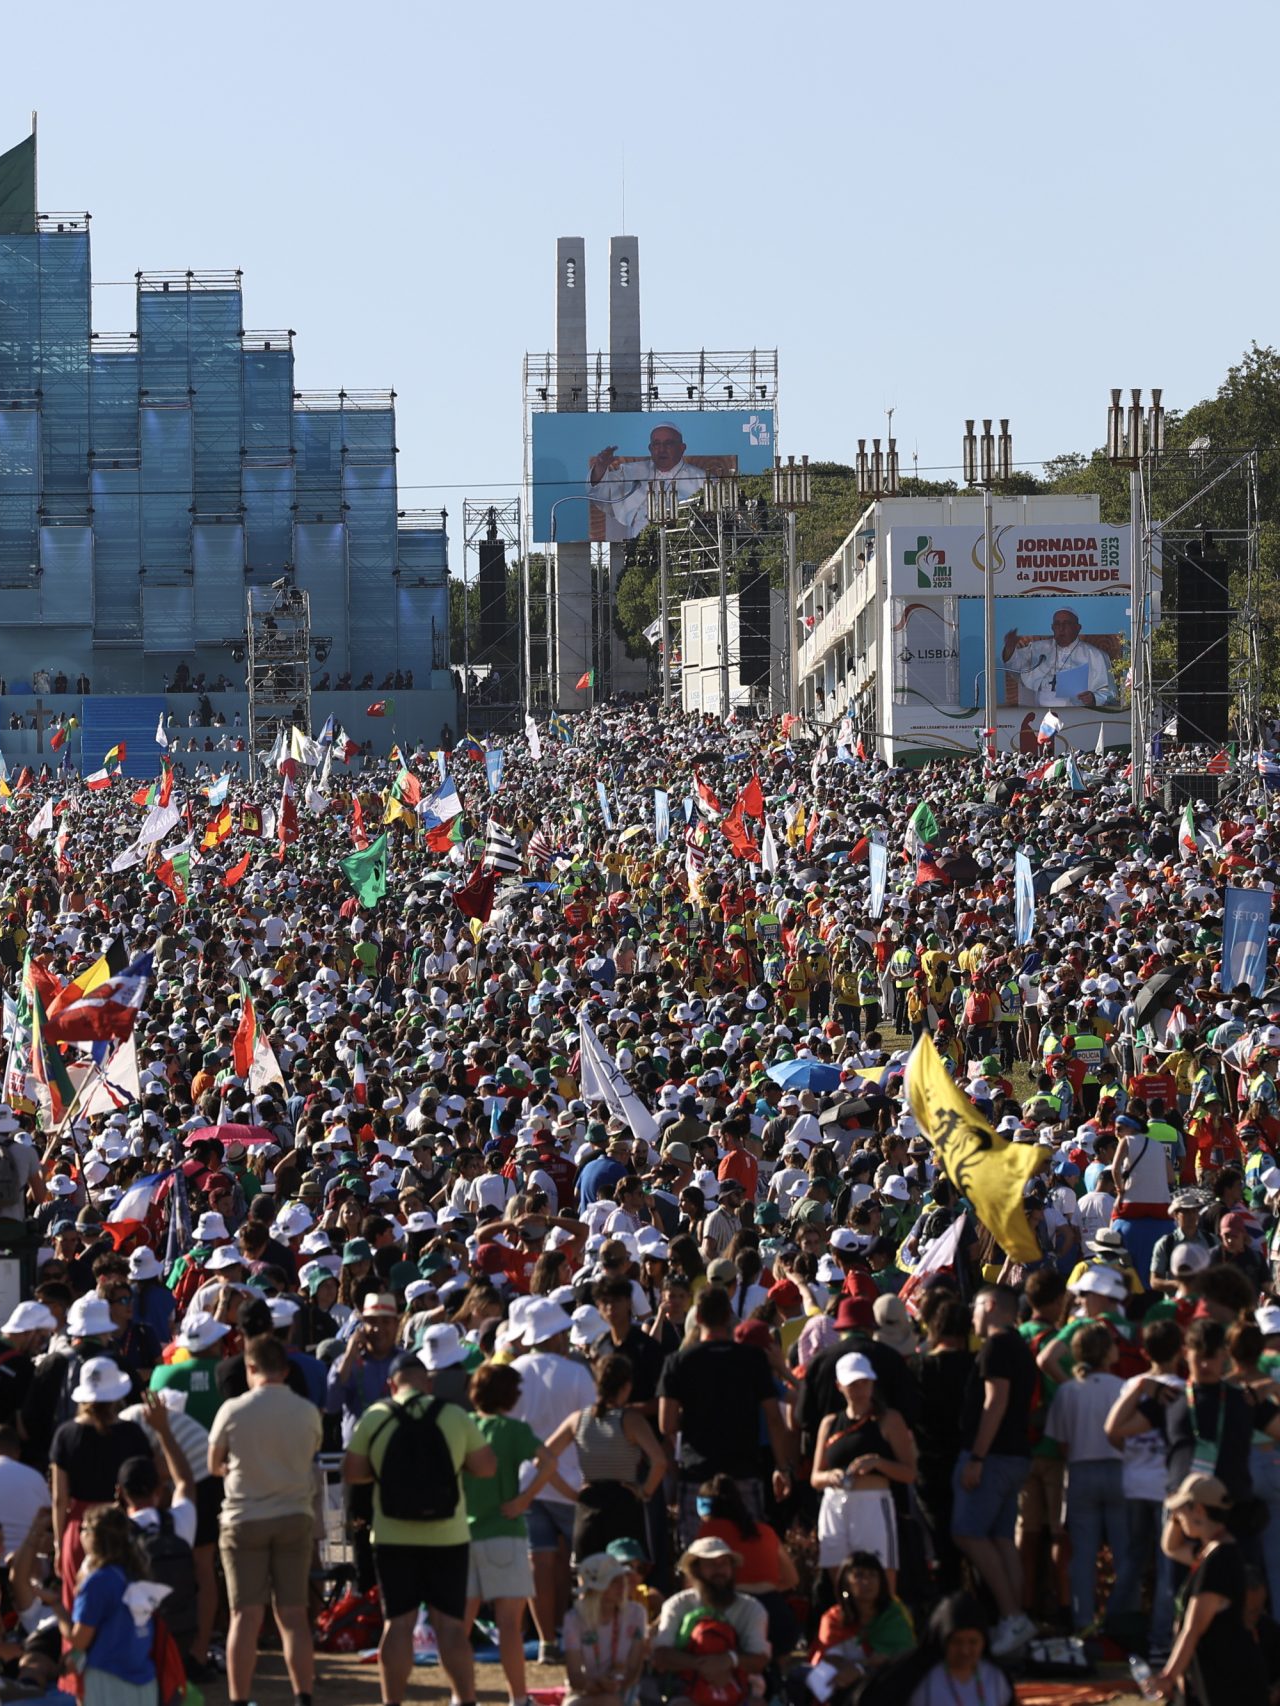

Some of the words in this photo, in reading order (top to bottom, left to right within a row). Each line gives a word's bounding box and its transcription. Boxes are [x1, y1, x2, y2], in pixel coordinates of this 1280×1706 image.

[1017, 538, 1098, 552] JORNADA
[1110, 537, 1119, 566] 2023
[1017, 554, 1099, 568] MUNDIAL
[933, 566, 952, 576] JMJ
[1017, 572, 1030, 581] da
[1032, 569, 1120, 582] JUVENTUDE
[918, 650, 958, 659] LISBOA
[1232, 910, 1264, 922] SETOR
